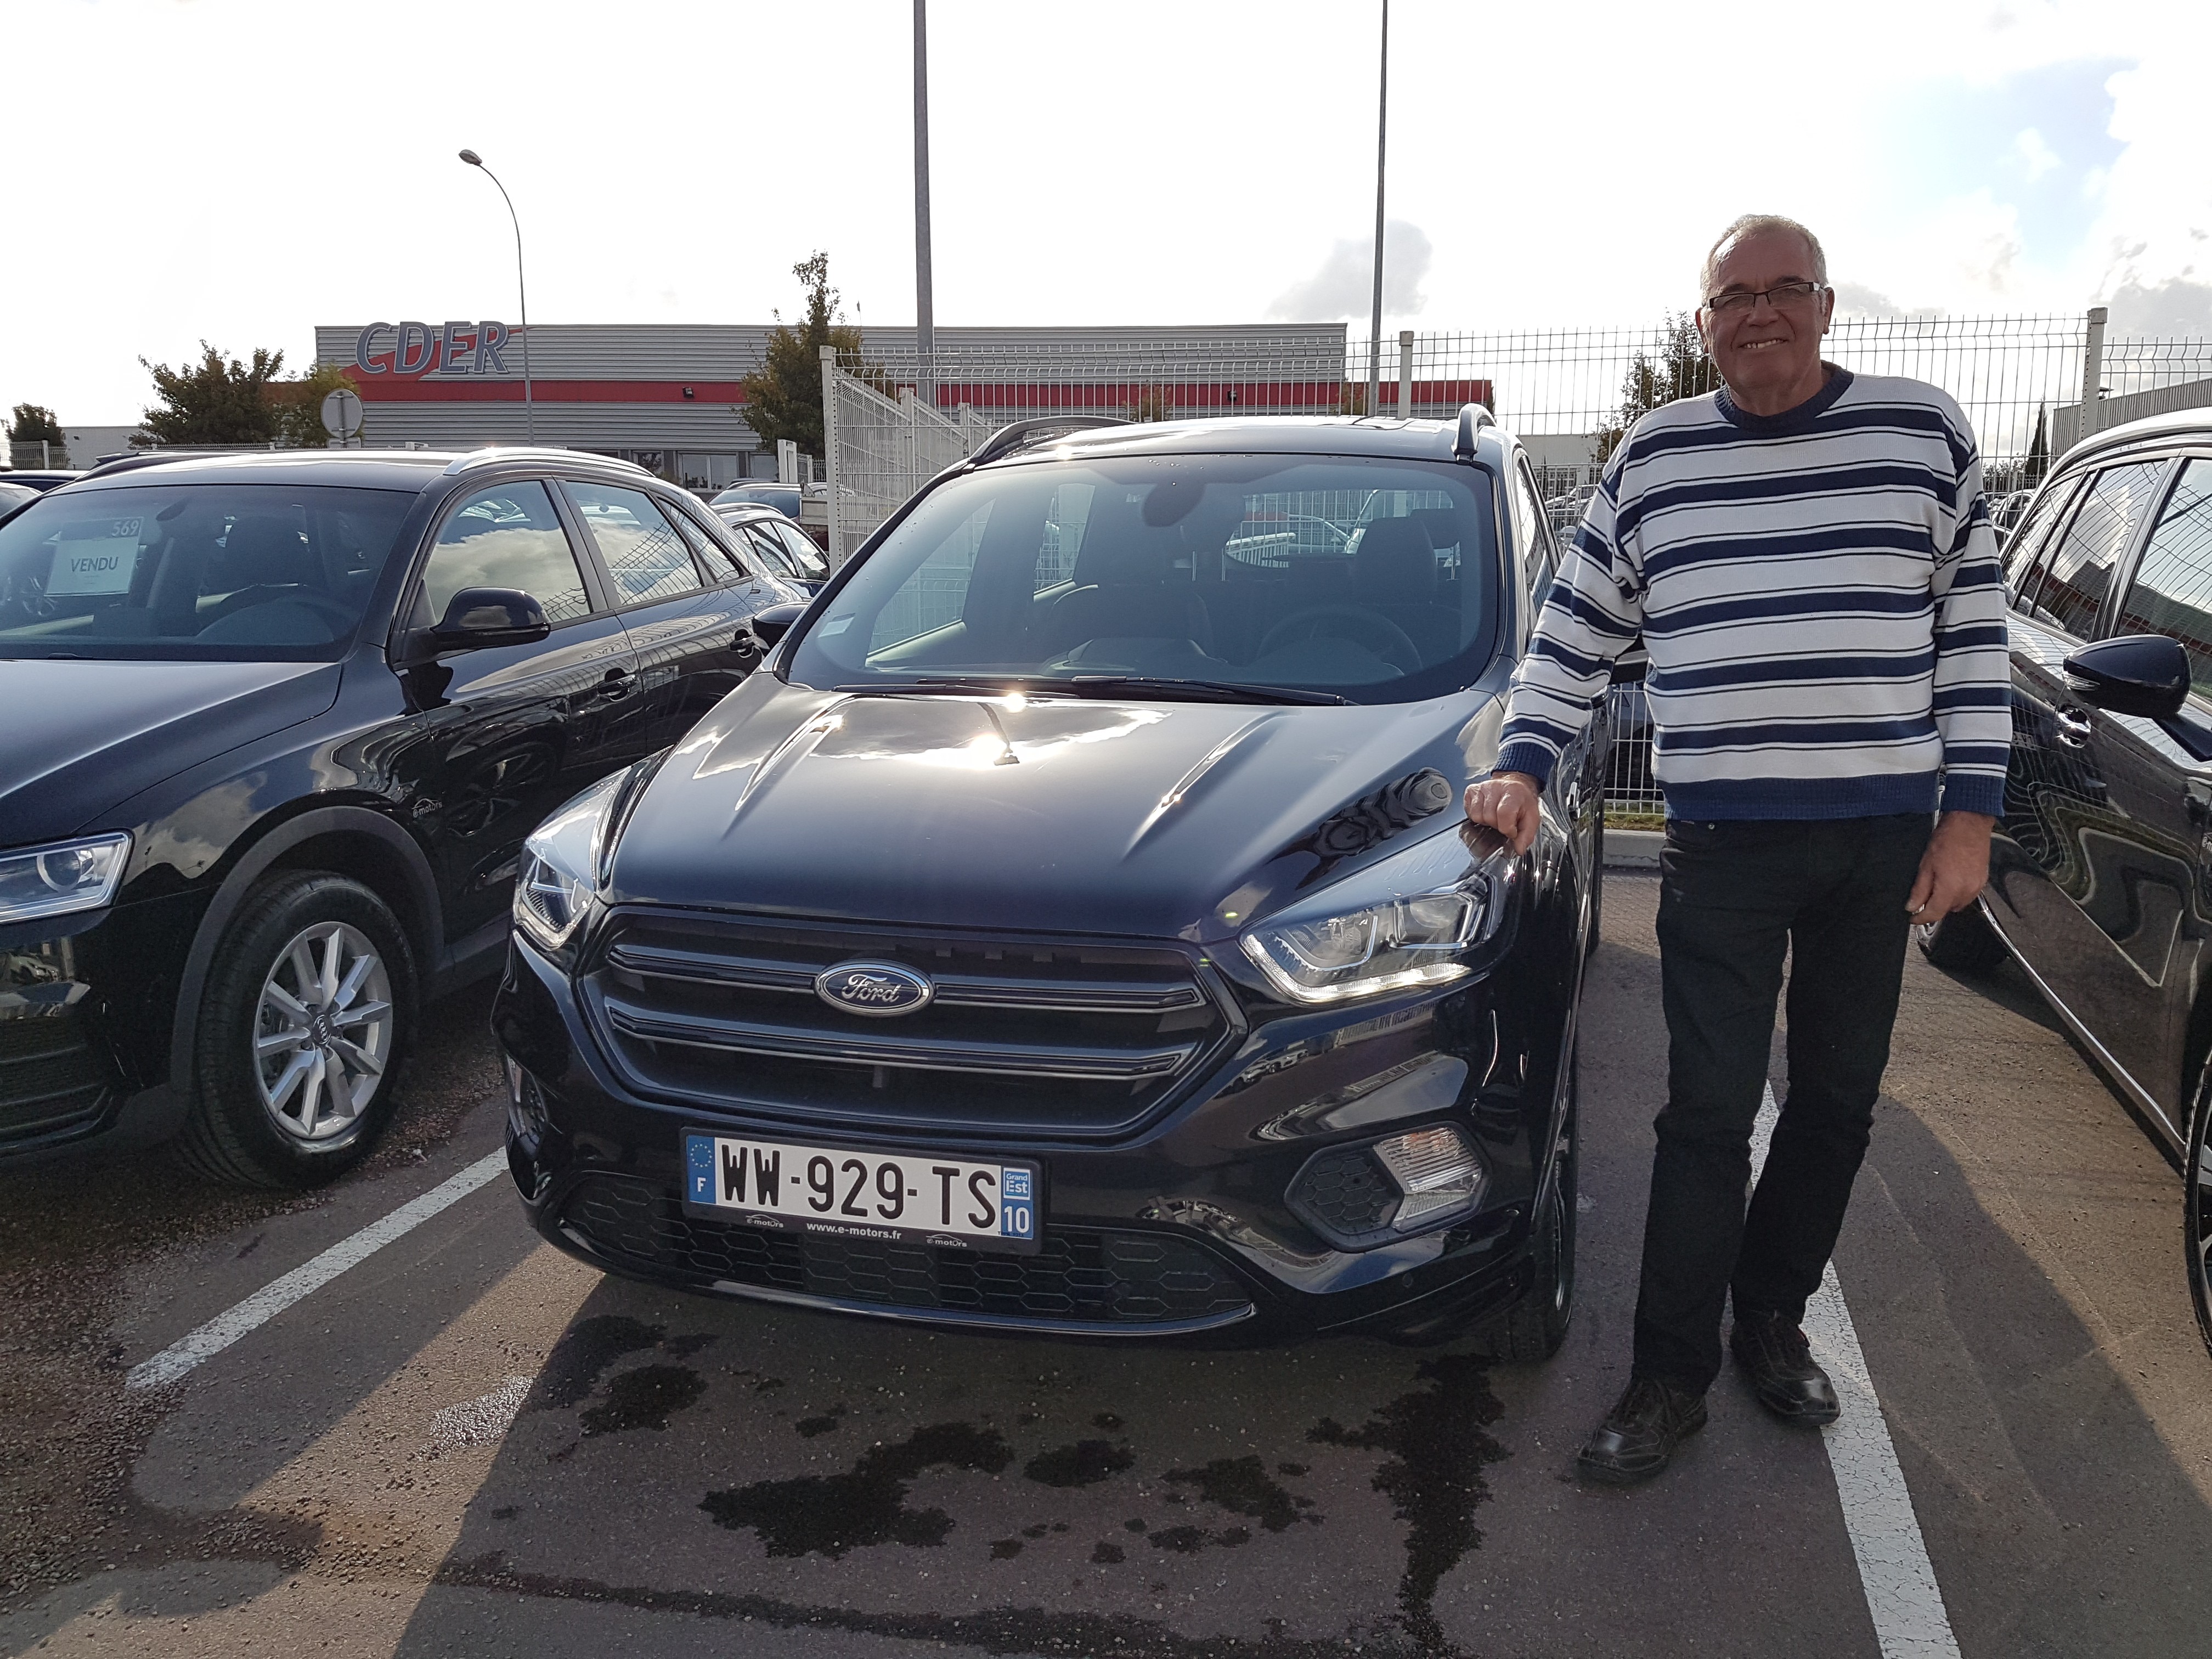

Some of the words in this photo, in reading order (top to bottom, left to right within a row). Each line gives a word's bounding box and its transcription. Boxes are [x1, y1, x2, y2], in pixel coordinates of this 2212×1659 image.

[356, 321, 510, 374] CDER
[111, 521, 139, 537] 569
[71, 556, 119, 572] VENDU
[842, 974, 902, 1003] Ford
[697, 1177, 707, 1192] F
[1006, 1173, 1028, 1181] Grand
[1006, 1180, 1028, 1194] Est
[1004, 1206, 1029, 1233] 10
[806, 1222, 902, 1240] www.e-motors.fr
